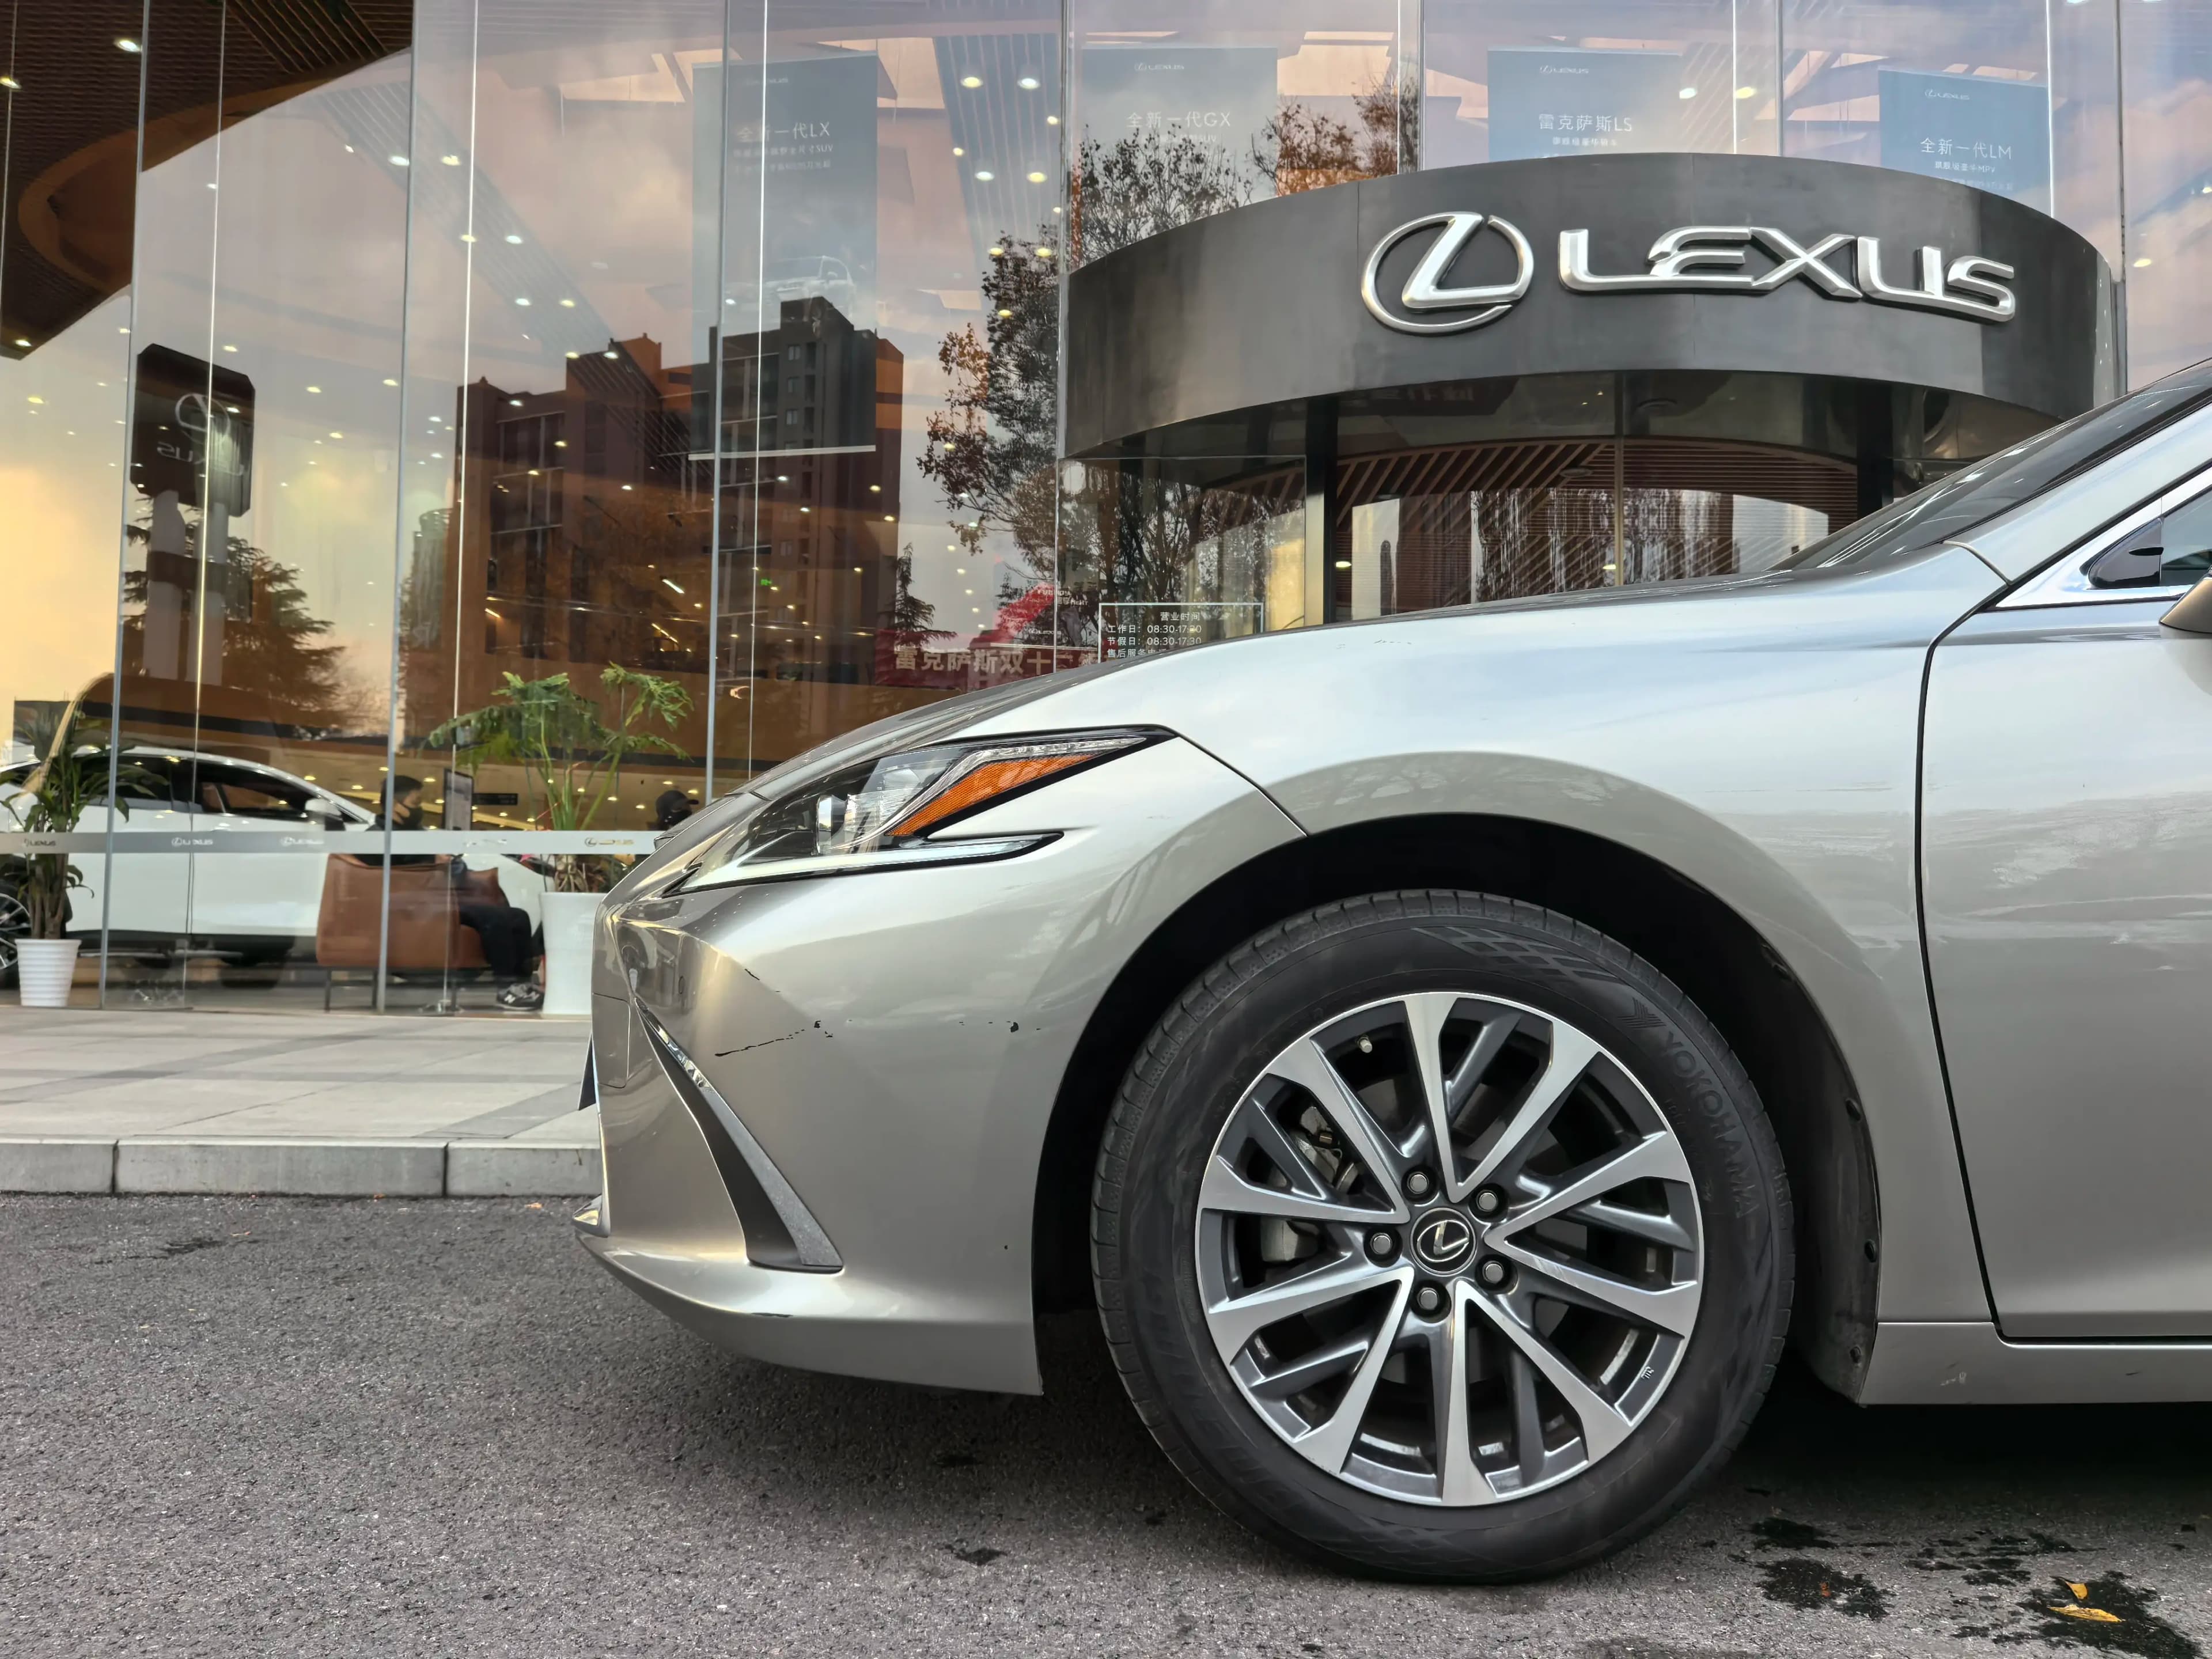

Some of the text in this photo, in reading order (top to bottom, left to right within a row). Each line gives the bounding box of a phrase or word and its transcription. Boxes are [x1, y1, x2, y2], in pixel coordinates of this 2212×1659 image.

[1126, 111, 1231, 128] 全新一代GX
[1539, 113, 1633, 132] 雷克萨斯LS
[1921, 137, 2012, 160] 全新一代LM
[1558, 226, 2016, 324] LEXUS
[1160, 612, 1200, 622] 营业时间
[1659, 1031, 1760, 1219] YOKOHAMA
